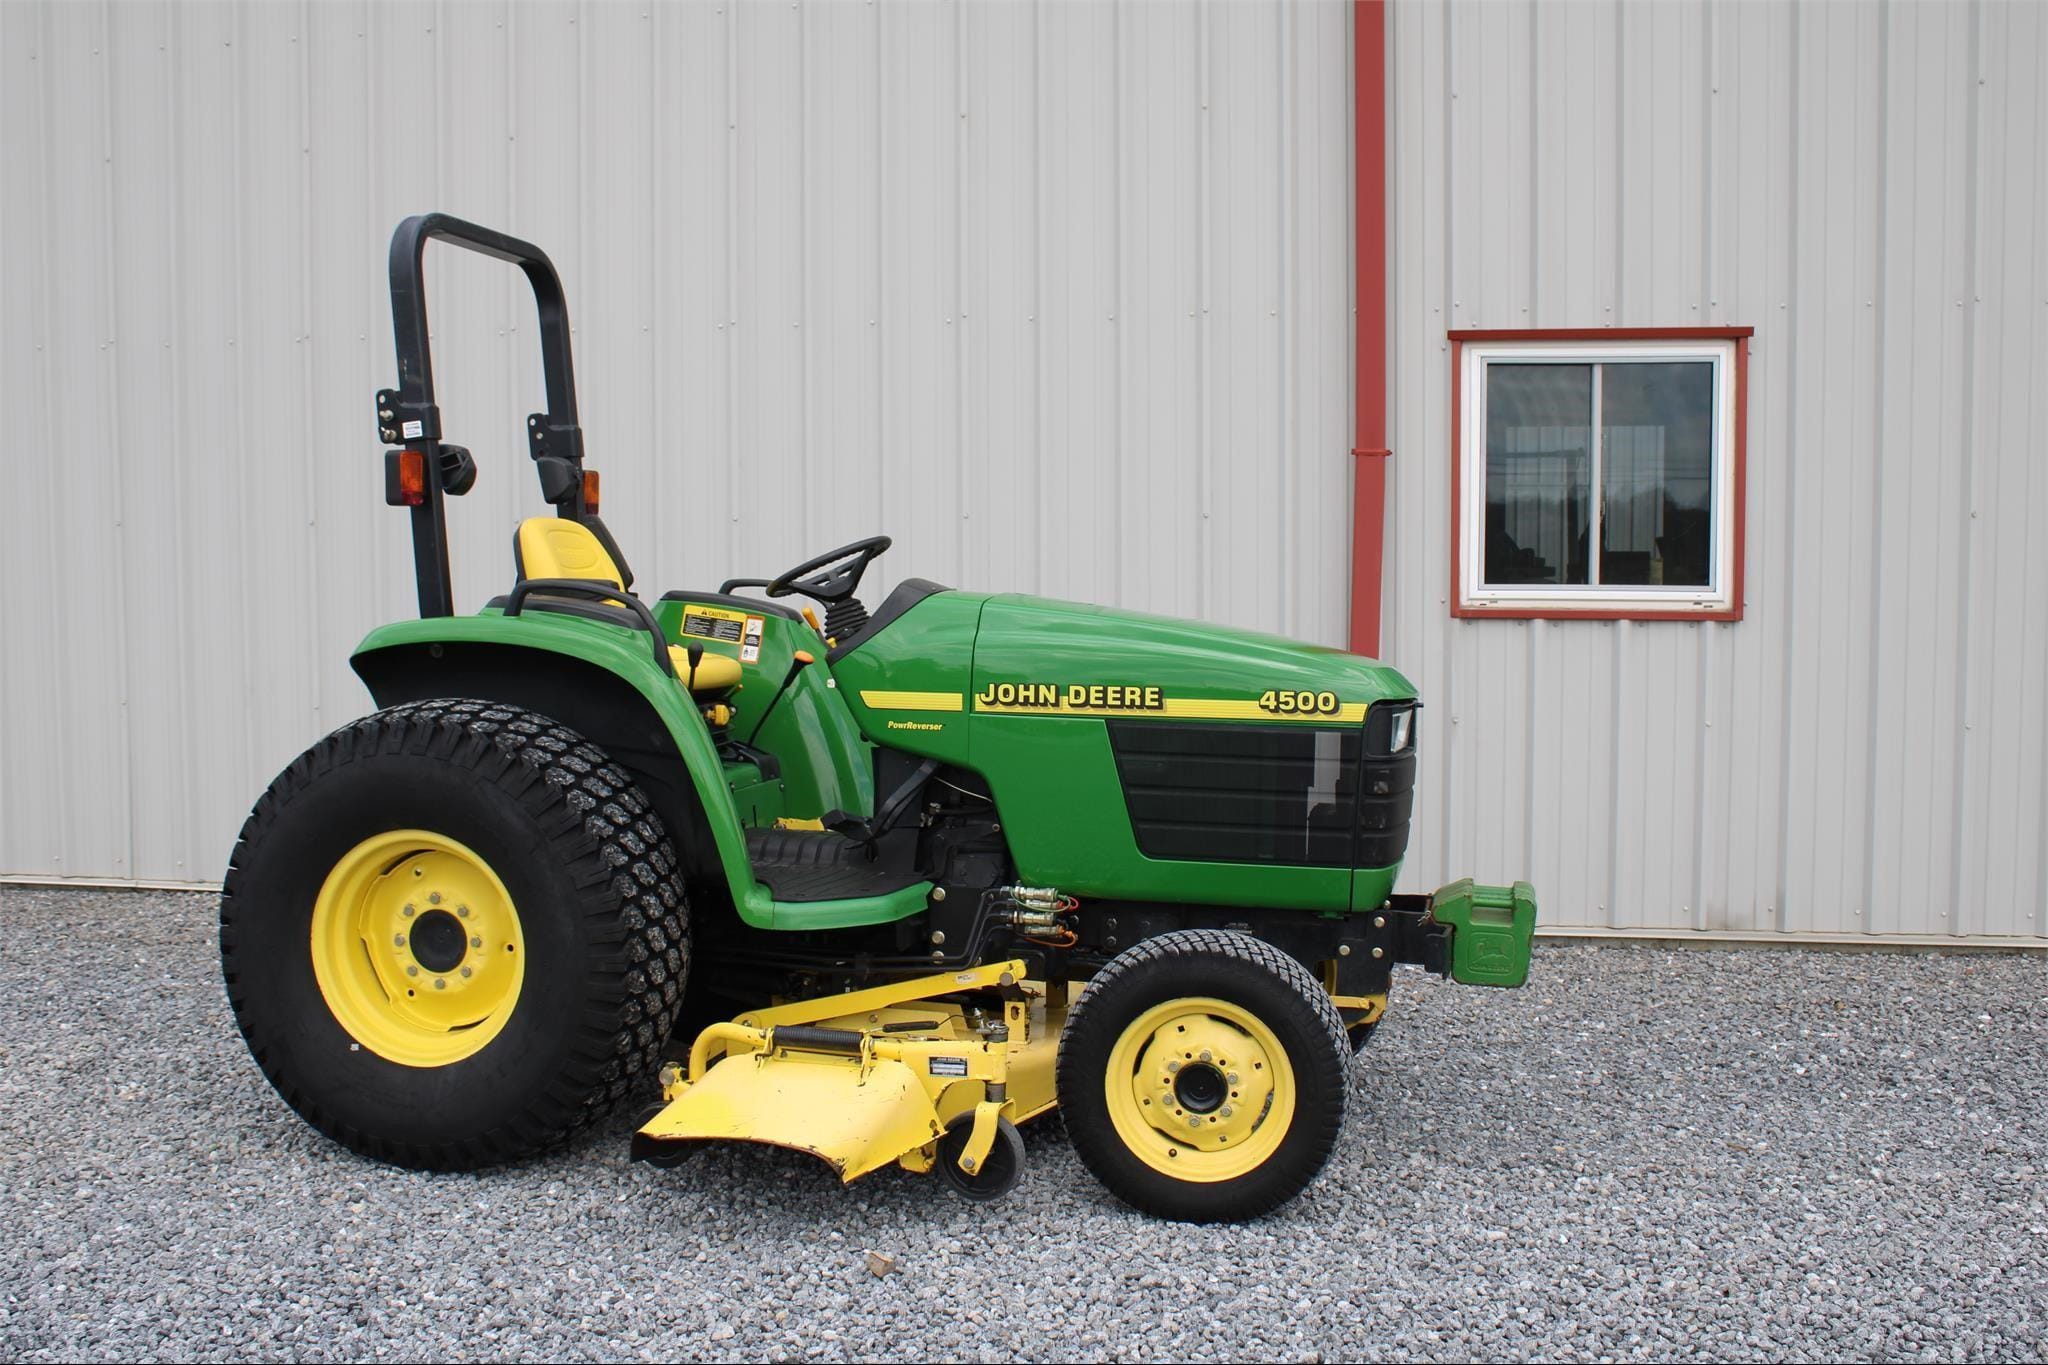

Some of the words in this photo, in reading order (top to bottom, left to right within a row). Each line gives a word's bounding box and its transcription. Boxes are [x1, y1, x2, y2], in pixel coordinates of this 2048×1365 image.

[979, 683, 1060, 707] JOHN
[1068, 685, 1163, 710] DEERE
[1259, 690, 1340, 714] 4500
[887, 720, 943, 731] PowrReverser
